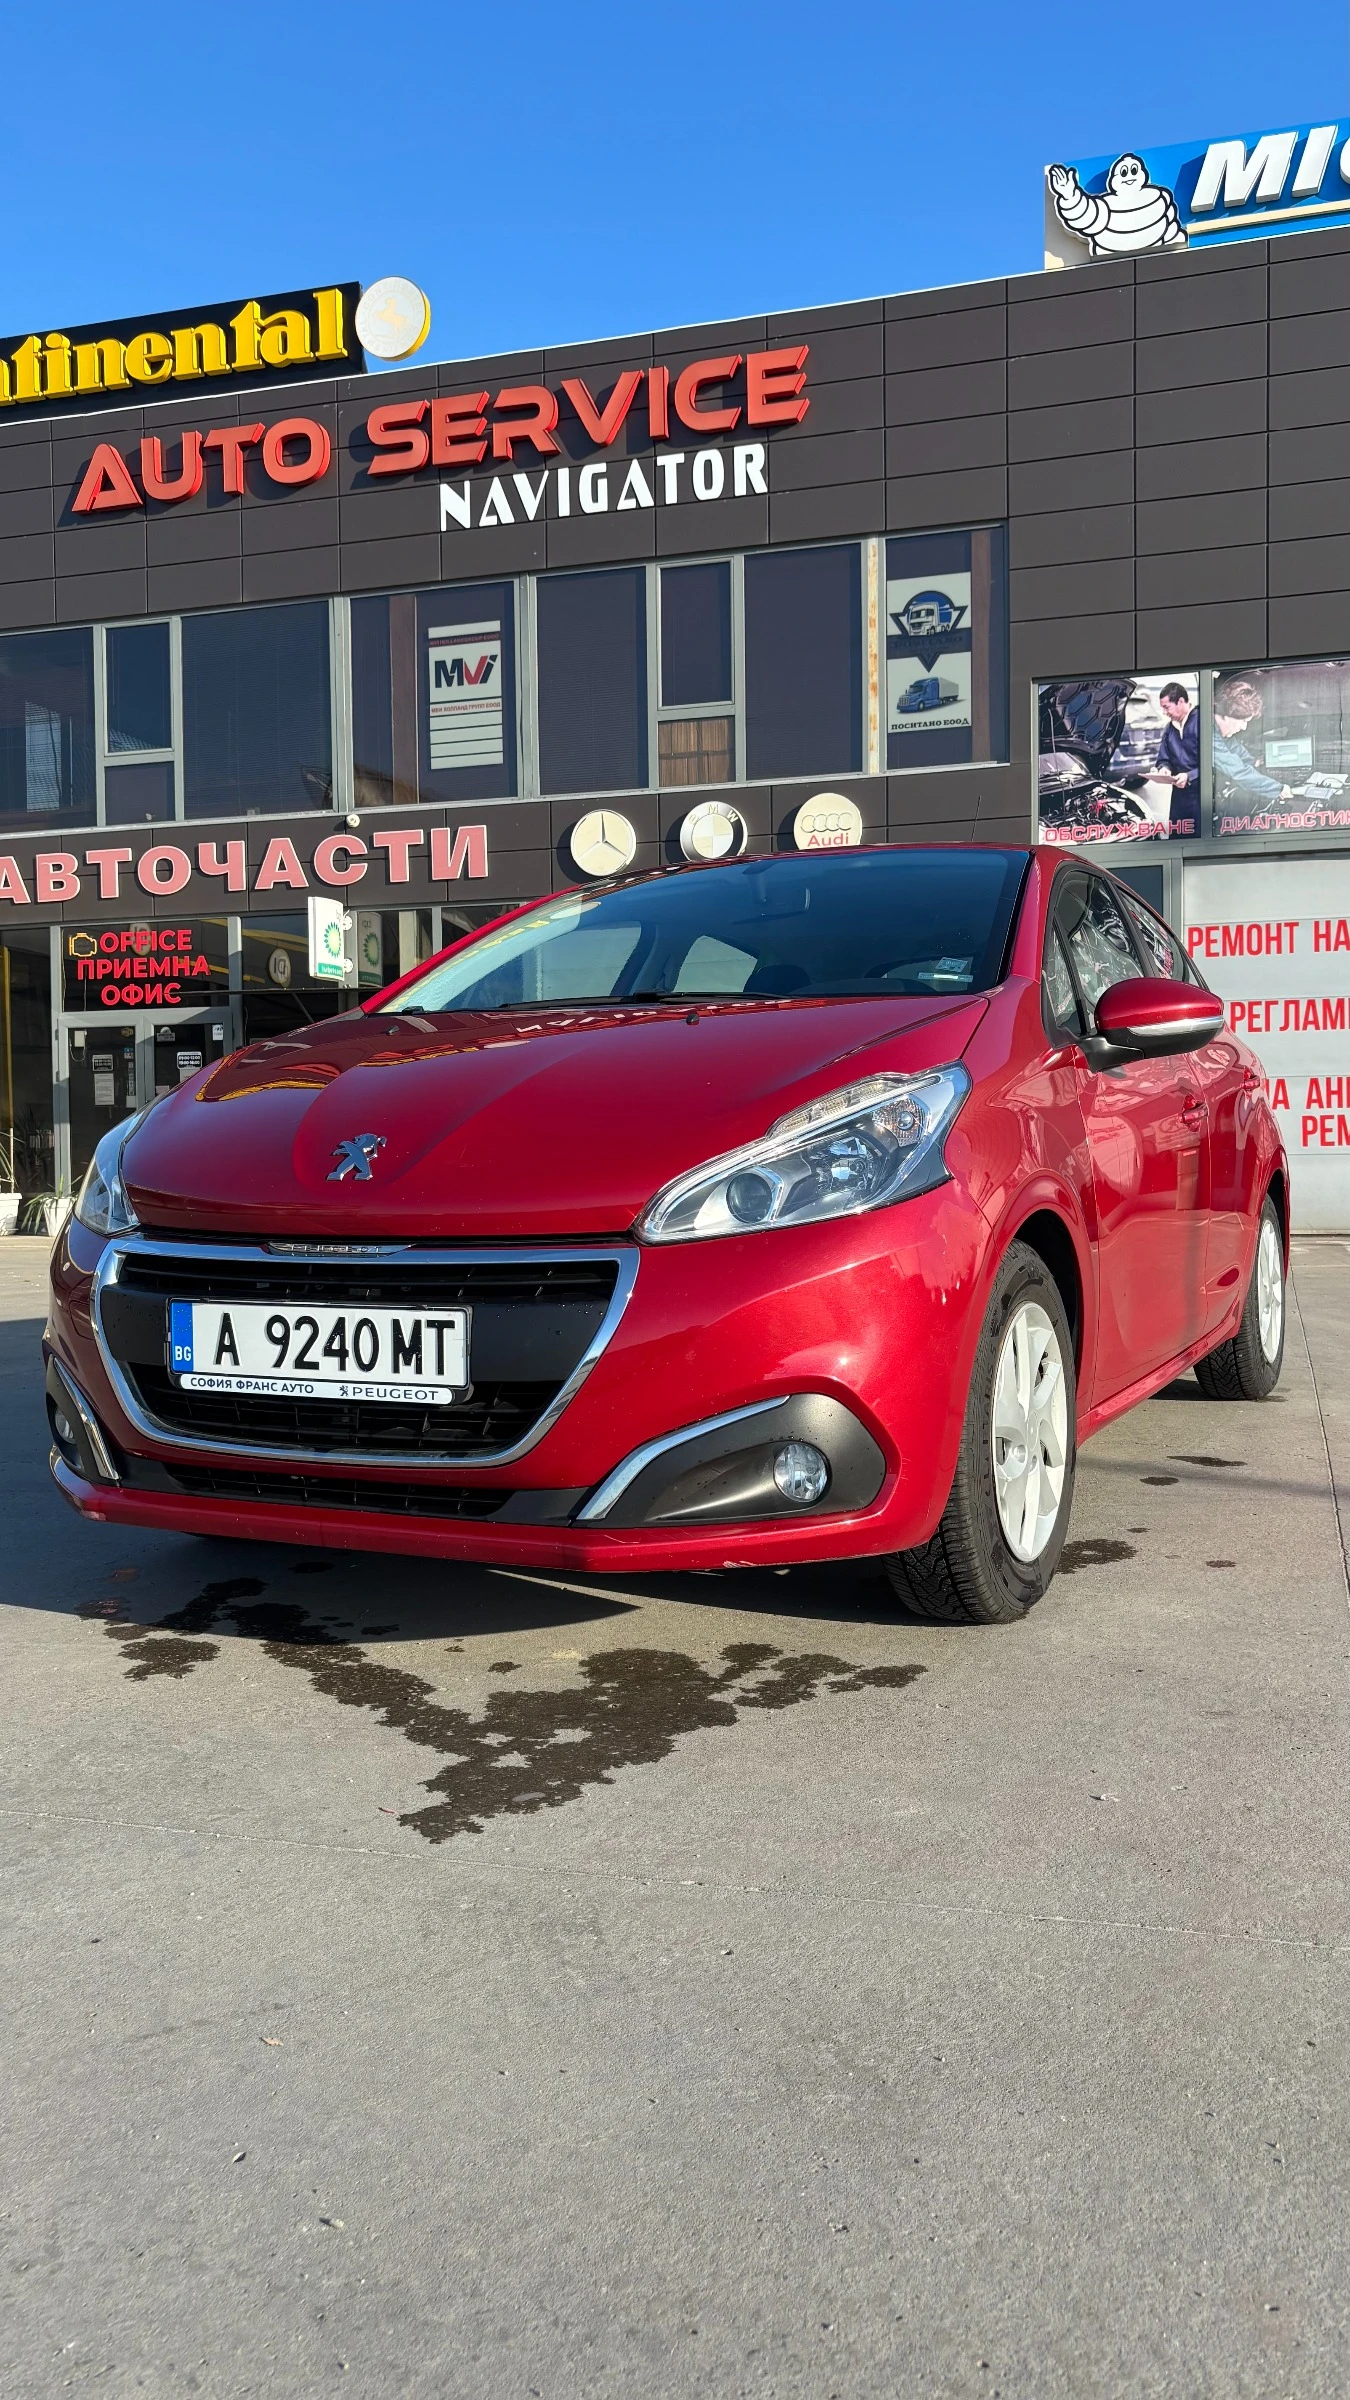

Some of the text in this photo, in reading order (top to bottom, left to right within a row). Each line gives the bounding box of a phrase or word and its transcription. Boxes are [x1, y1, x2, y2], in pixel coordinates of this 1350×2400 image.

[1191, 124, 1350, 213] MI
[0, 288, 348, 406] tinental
[72, 345, 809, 514] AUTO SERVICE
[440, 443, 768, 532] NAVIGATOR
[943, 717, 970, 727] ЕООД
[1045, 818, 1196, 842] ОБСЛУЖВАНЕ
[1220, 809, 1350, 835] ДИАГНОСТИ
[807, 833, 849, 847] Audi
[100, 929, 193, 954] OFFICE
[1187, 919, 1350, 959] РЕМОНТ НА
[77, 955, 212, 981] ПРИЕМНА
[101, 982, 182, 1006] ОФИС
[1230, 997, 1350, 1033] РЕГЛАМ
[1264, 1076, 1350, 1110] А АН
[174, 1346, 192, 1361] BG
[264, 1314, 379, 1373] 9240
[190, 1377, 315, 1394] СОФИЯ ФРАНС АУТО
[353, 1386, 439, 1401] PEUGEOT
